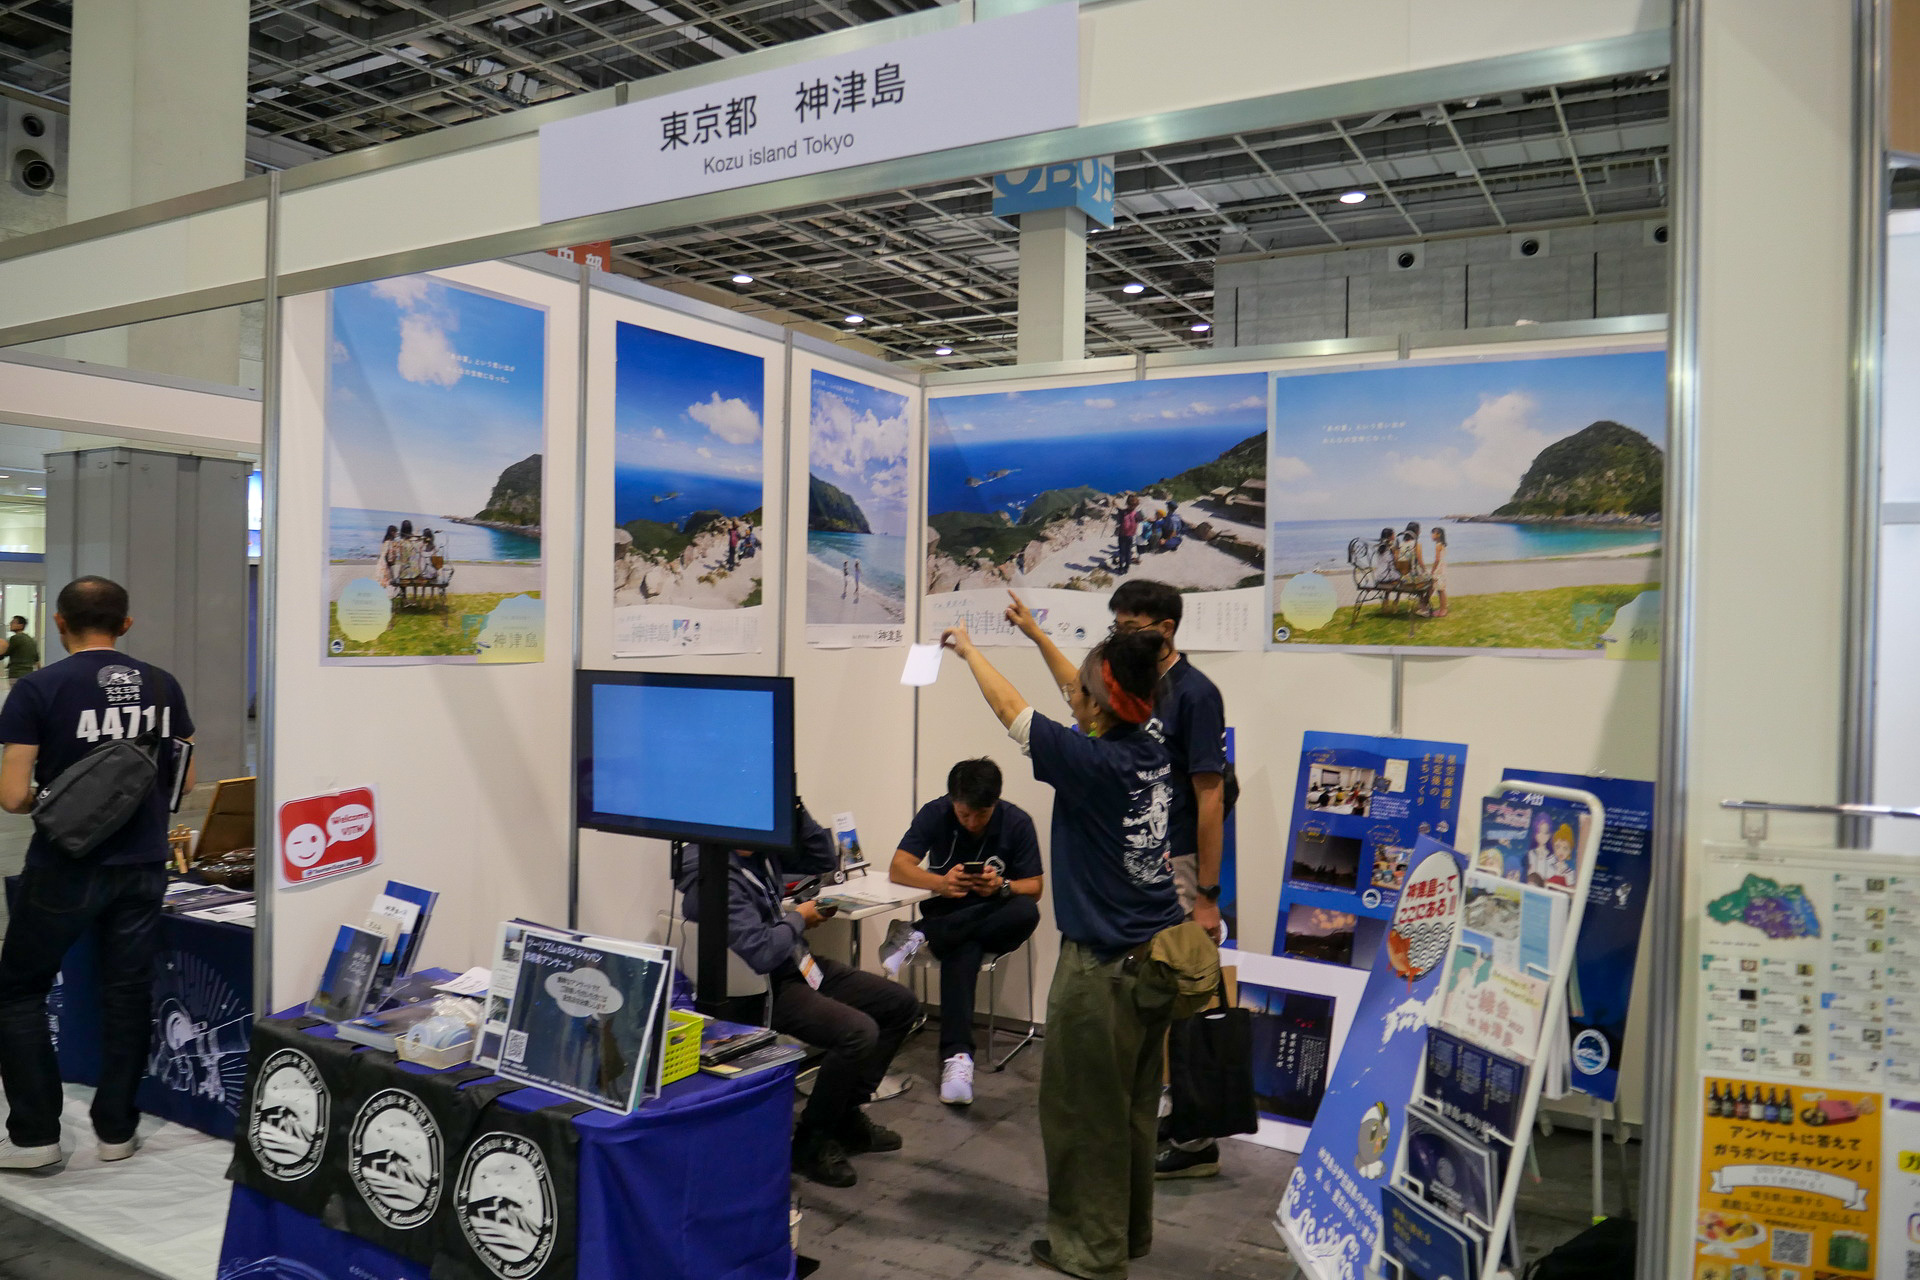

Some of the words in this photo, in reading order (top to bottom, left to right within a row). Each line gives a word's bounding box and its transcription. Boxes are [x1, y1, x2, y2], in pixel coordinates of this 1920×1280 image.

[659, 94, 758, 152] 東京都
[794, 62, 906, 124] 神津島
[703, 151, 744, 175] Kozu
[748, 141, 798, 168] island
[803, 130, 854, 157] Tokyo
[331, 811, 370, 826] Welcome
[1406, 874, 1458, 903] 神津島って
[1729, 1125, 1862, 1151] アンケートに答えて
